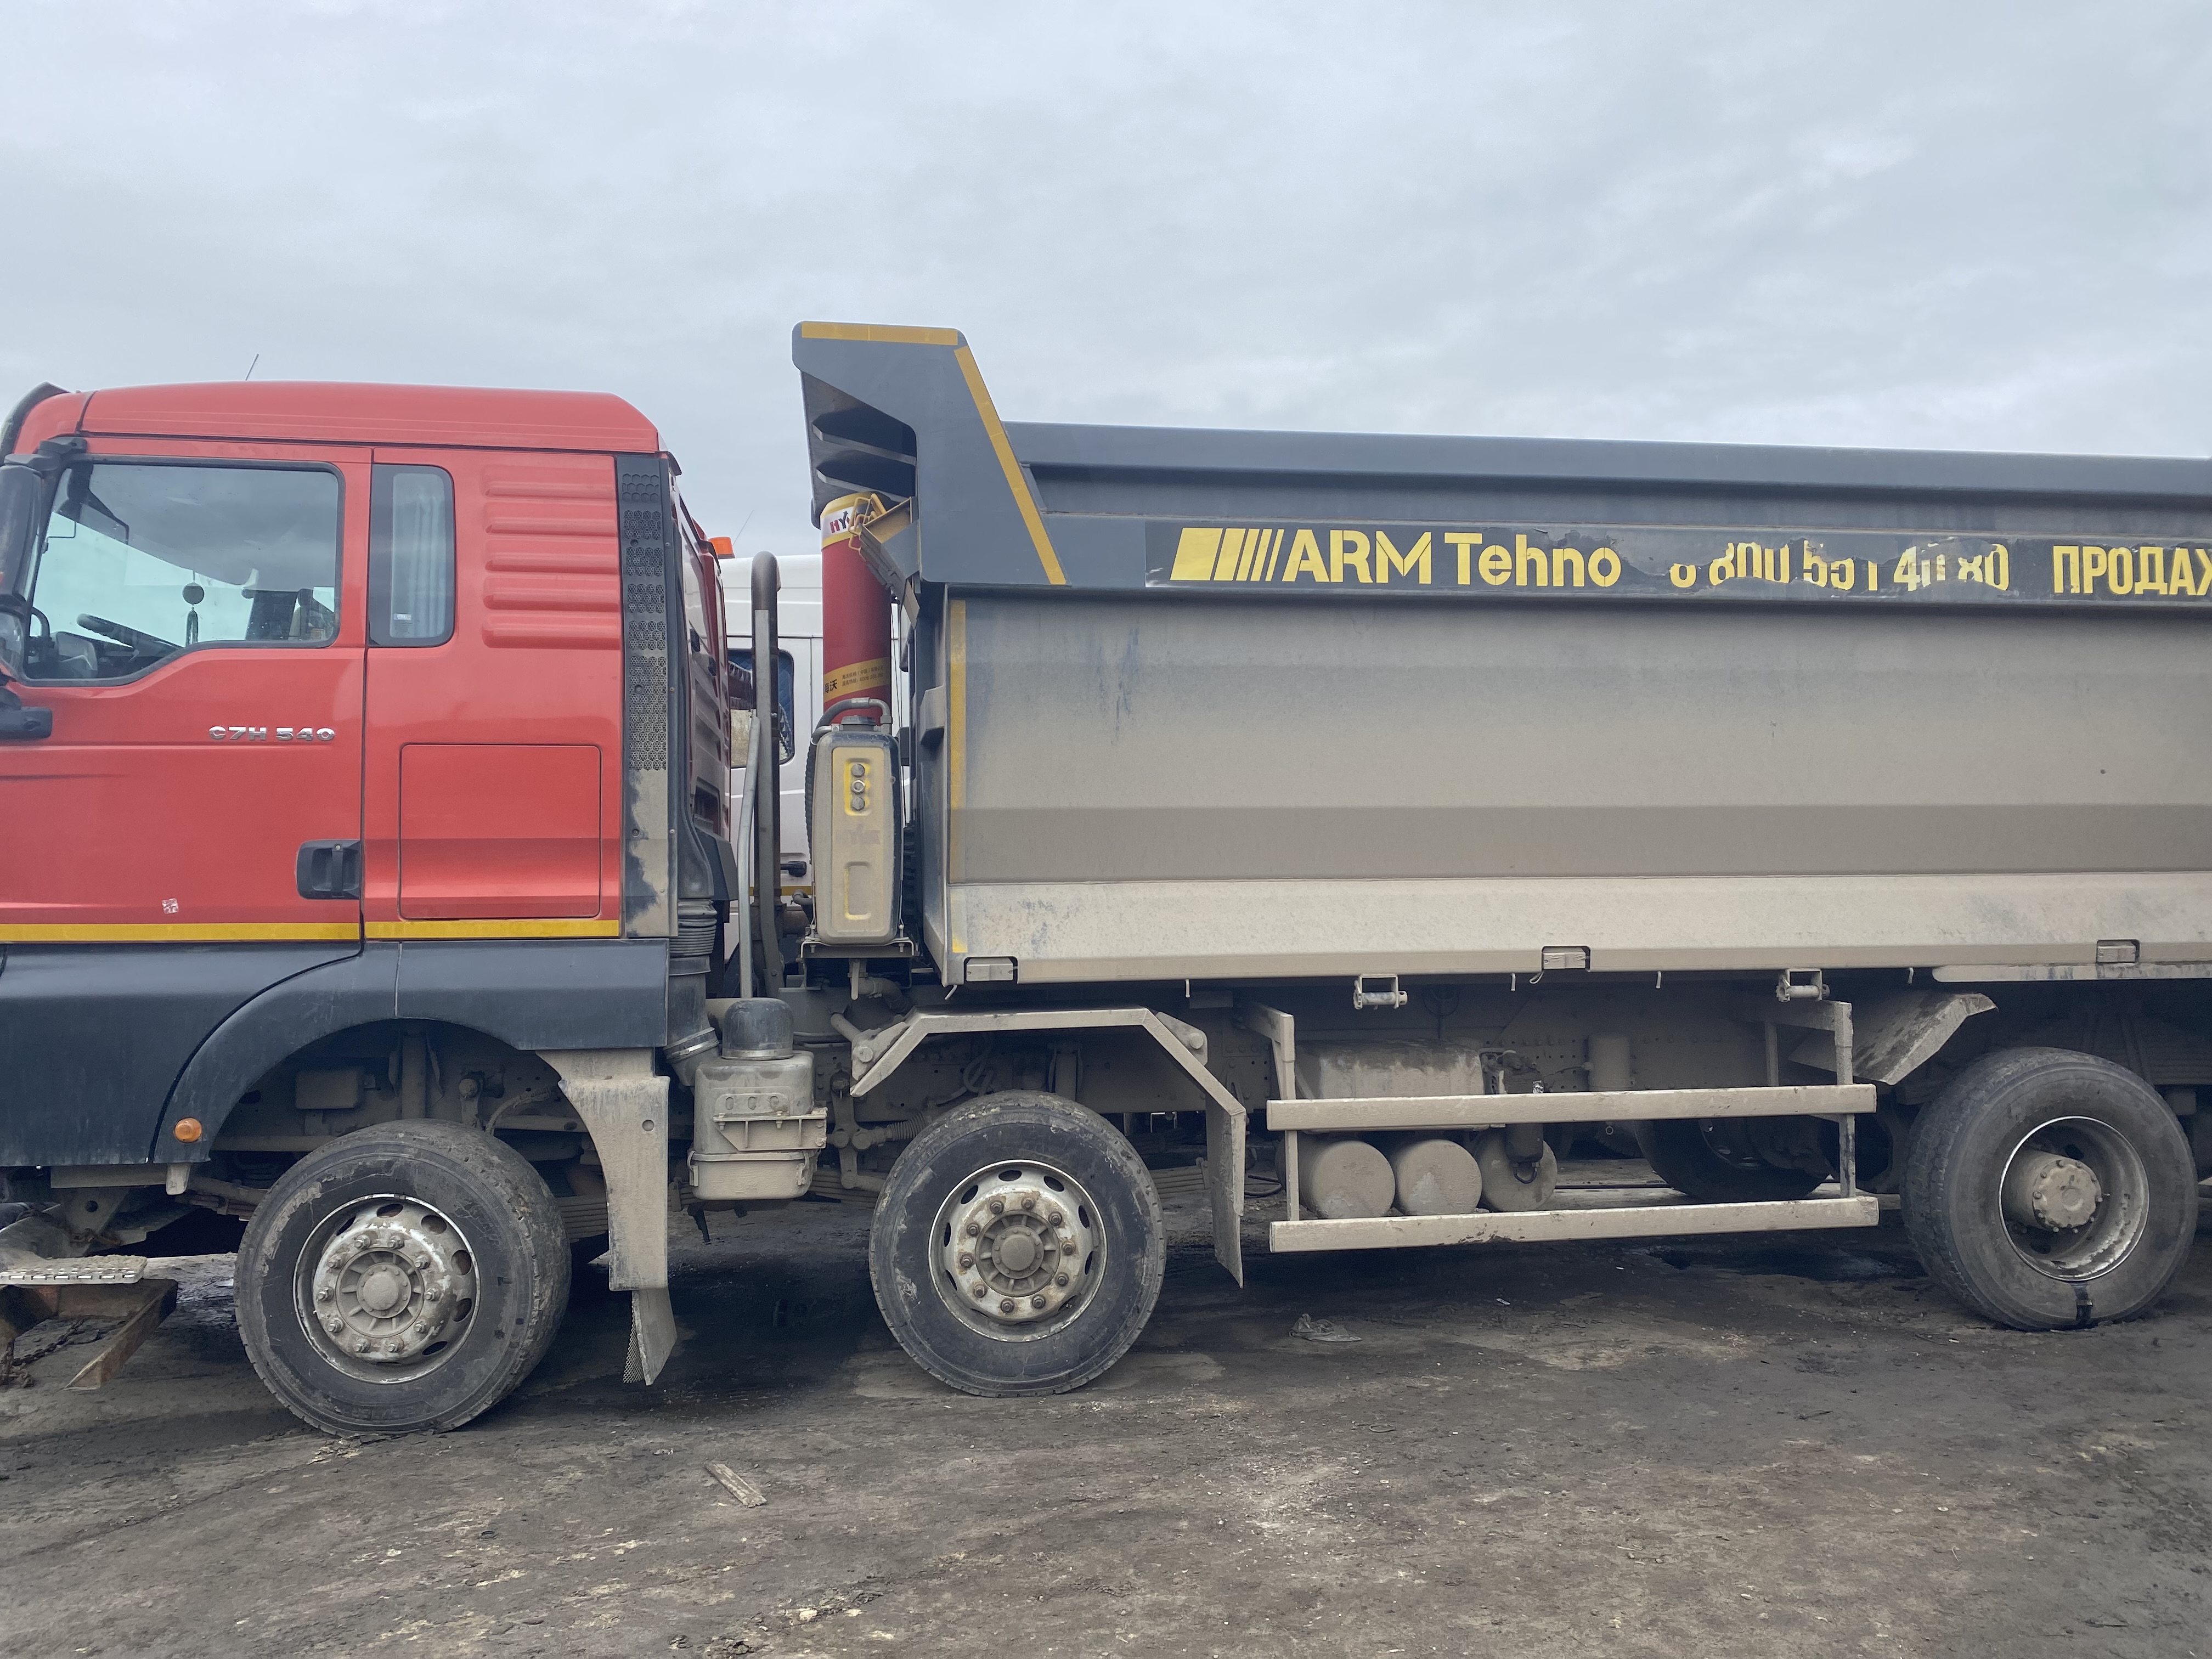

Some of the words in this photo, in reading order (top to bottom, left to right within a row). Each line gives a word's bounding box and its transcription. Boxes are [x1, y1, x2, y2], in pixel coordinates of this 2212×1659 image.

[1282, 529, 1432, 584] ARM
[1444, 532, 1622, 588] Tehno
[208, 726, 267, 741] C7H
[275, 727, 335, 741] 540
